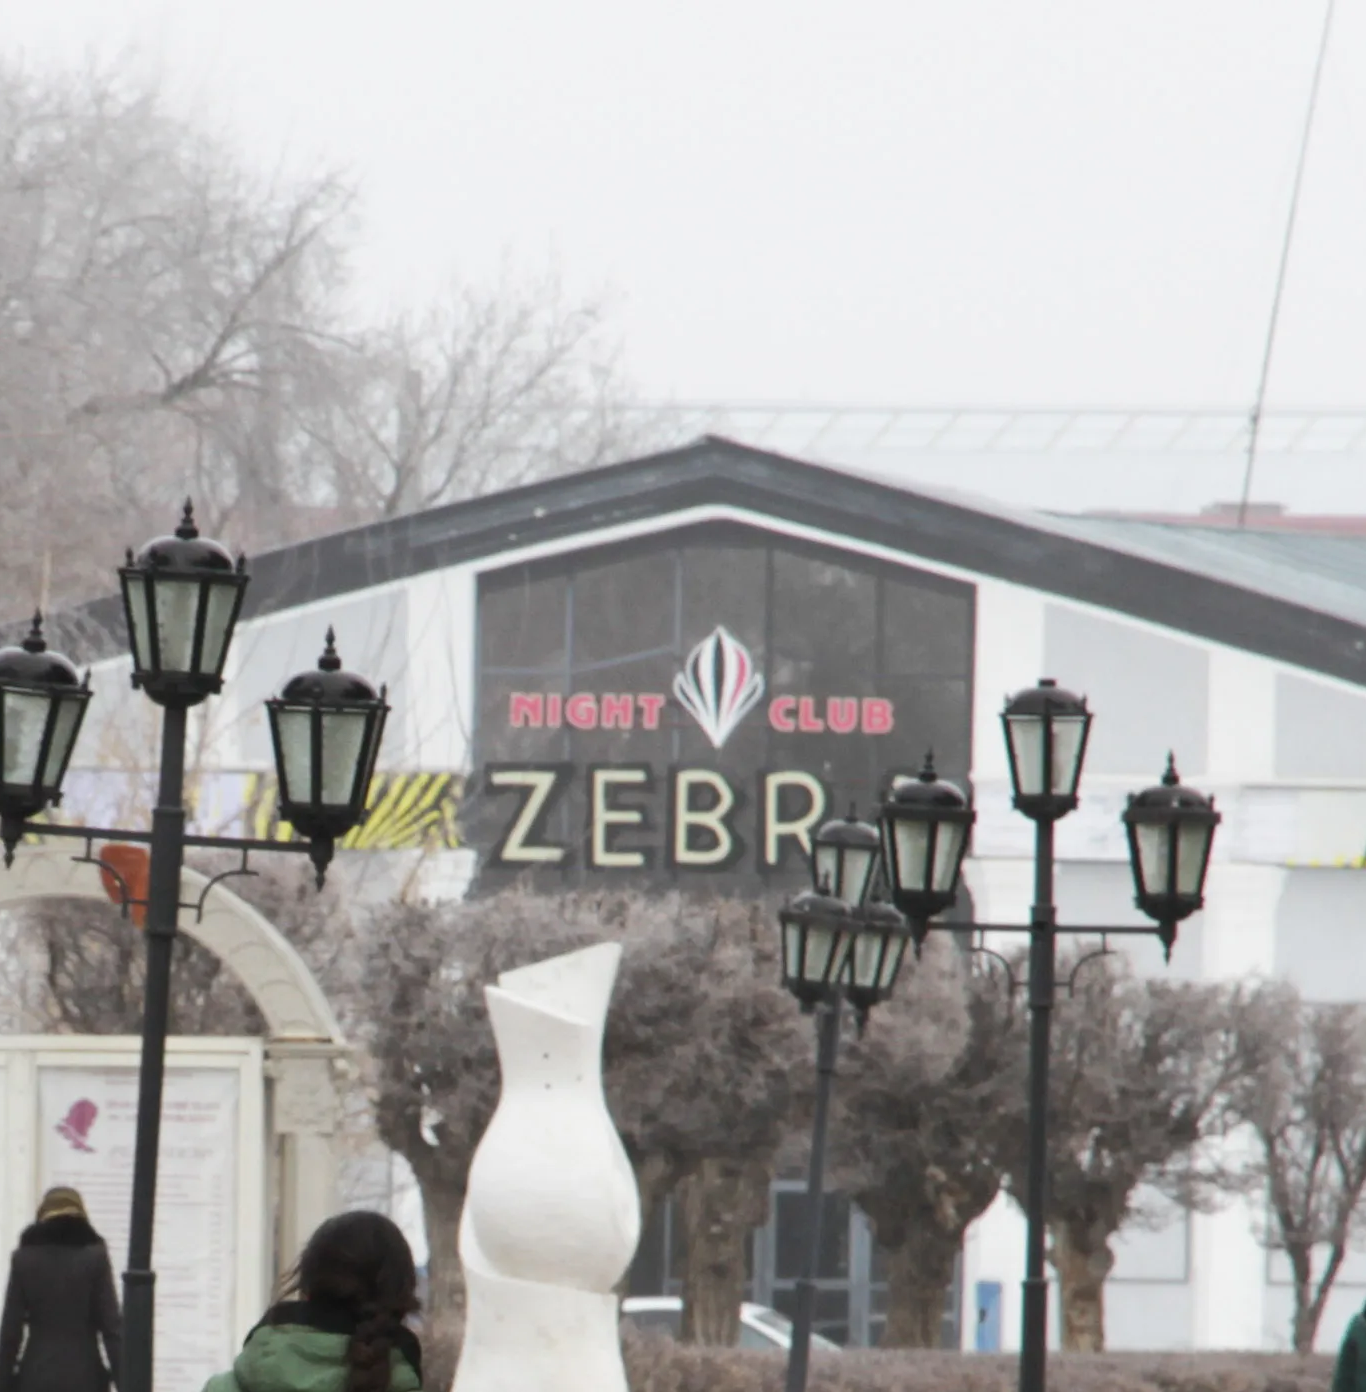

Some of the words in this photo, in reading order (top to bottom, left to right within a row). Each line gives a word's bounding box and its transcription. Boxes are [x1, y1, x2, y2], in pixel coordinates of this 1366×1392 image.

[510, 691, 667, 730] NIGHT
[768, 696, 894, 734] CLUB
[491, 769, 910, 867] ZEBR
